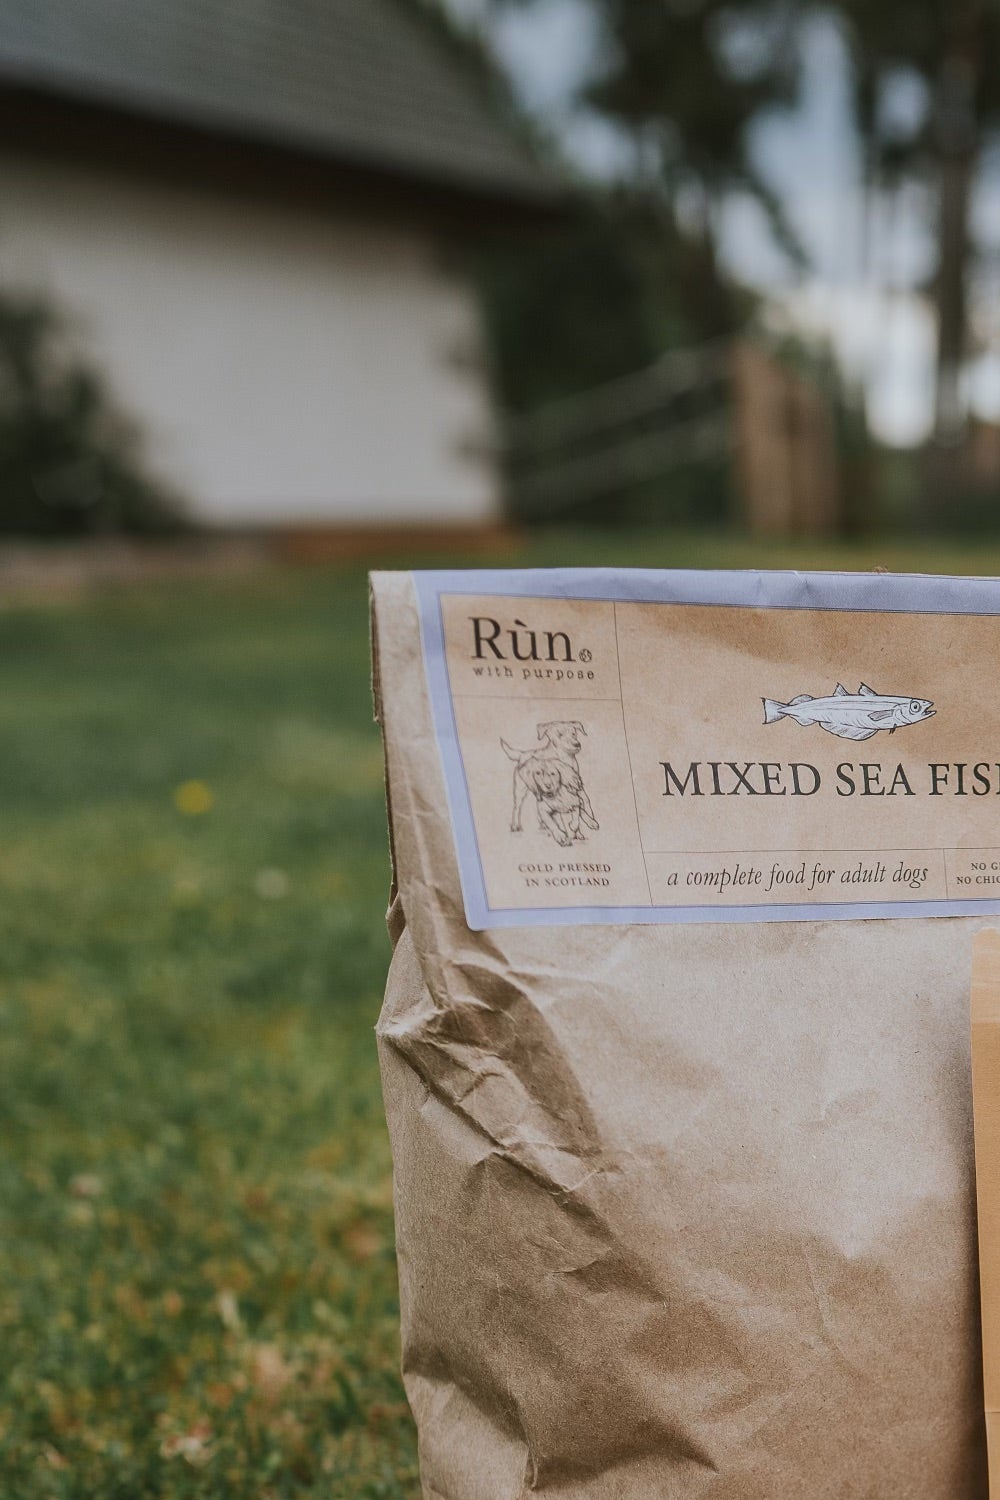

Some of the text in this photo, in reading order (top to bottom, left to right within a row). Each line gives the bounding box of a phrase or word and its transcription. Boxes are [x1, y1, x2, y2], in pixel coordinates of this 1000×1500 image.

[472, 665, 595, 681] with purpose
[659, 761, 822, 797] MIXED
[835, 762, 916, 797] SEA
[518, 863, 611, 872] COLD PRESSED
[971, 862, 987, 871] NO
[526, 877, 610, 887] IN SCOTLAND
[667, 862, 929, 893] a complete food for adult dogs
[956, 876, 971, 884] NO
